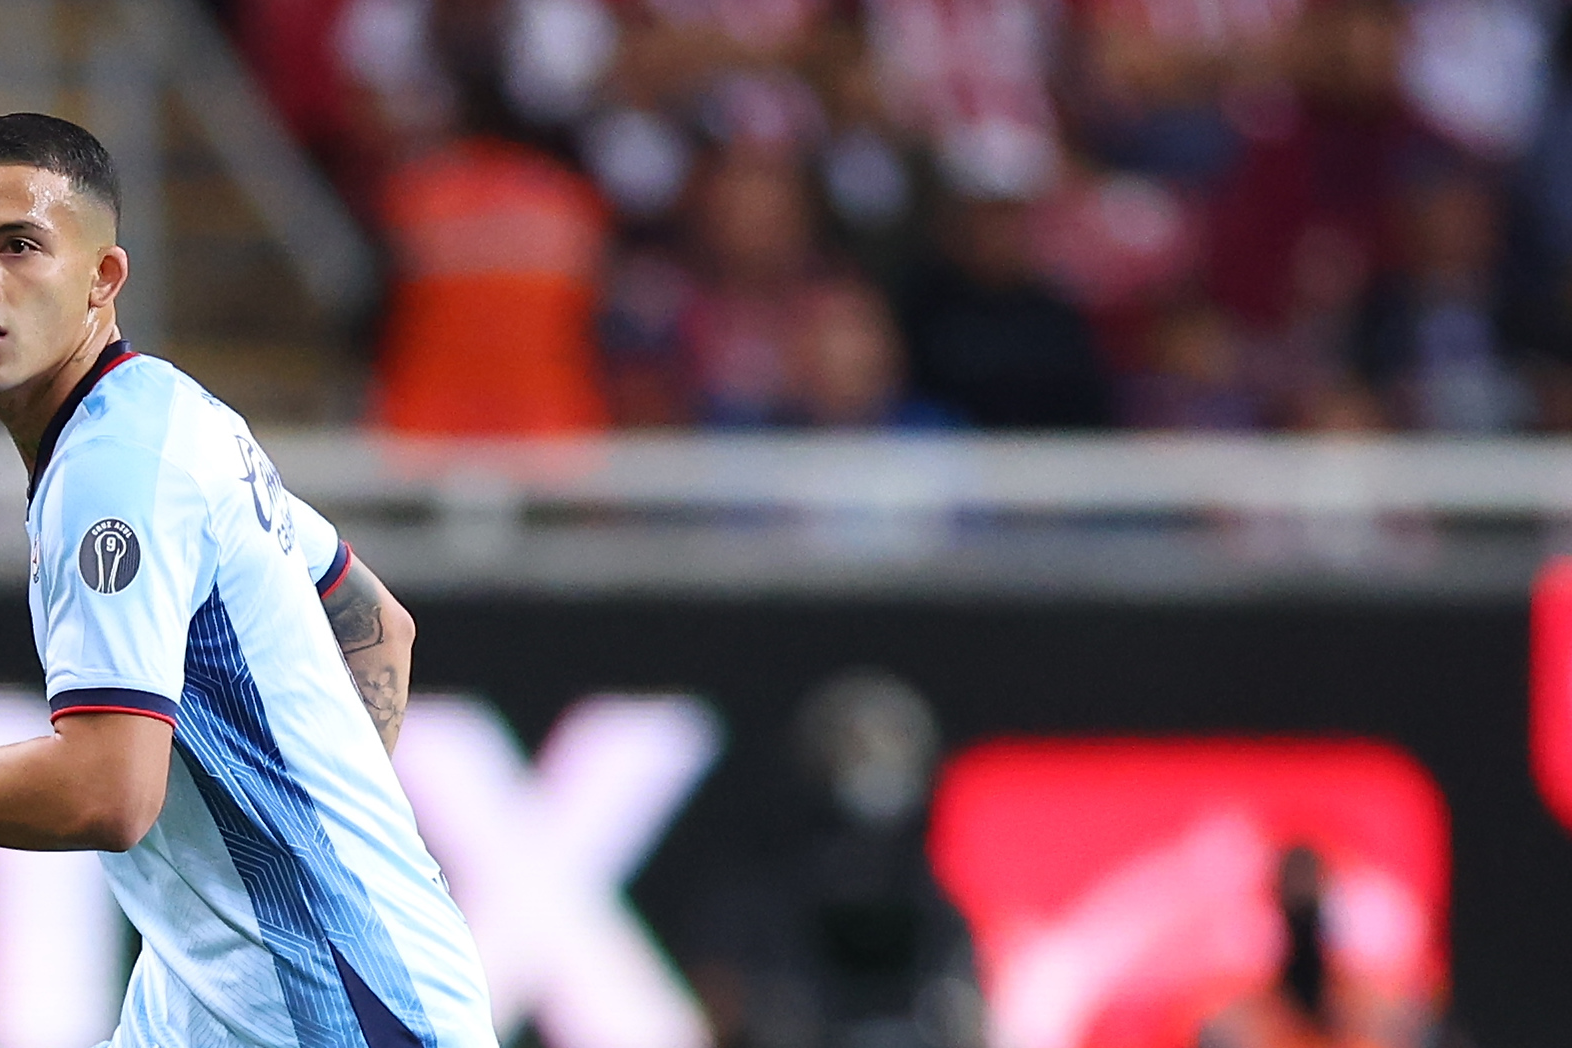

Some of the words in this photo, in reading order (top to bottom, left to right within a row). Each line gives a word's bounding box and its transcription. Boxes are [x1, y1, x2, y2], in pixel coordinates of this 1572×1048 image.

[91, 521, 112, 536] CRUZ
[113, 521, 134, 539] AZUL
[106, 537, 117, 552] 9
